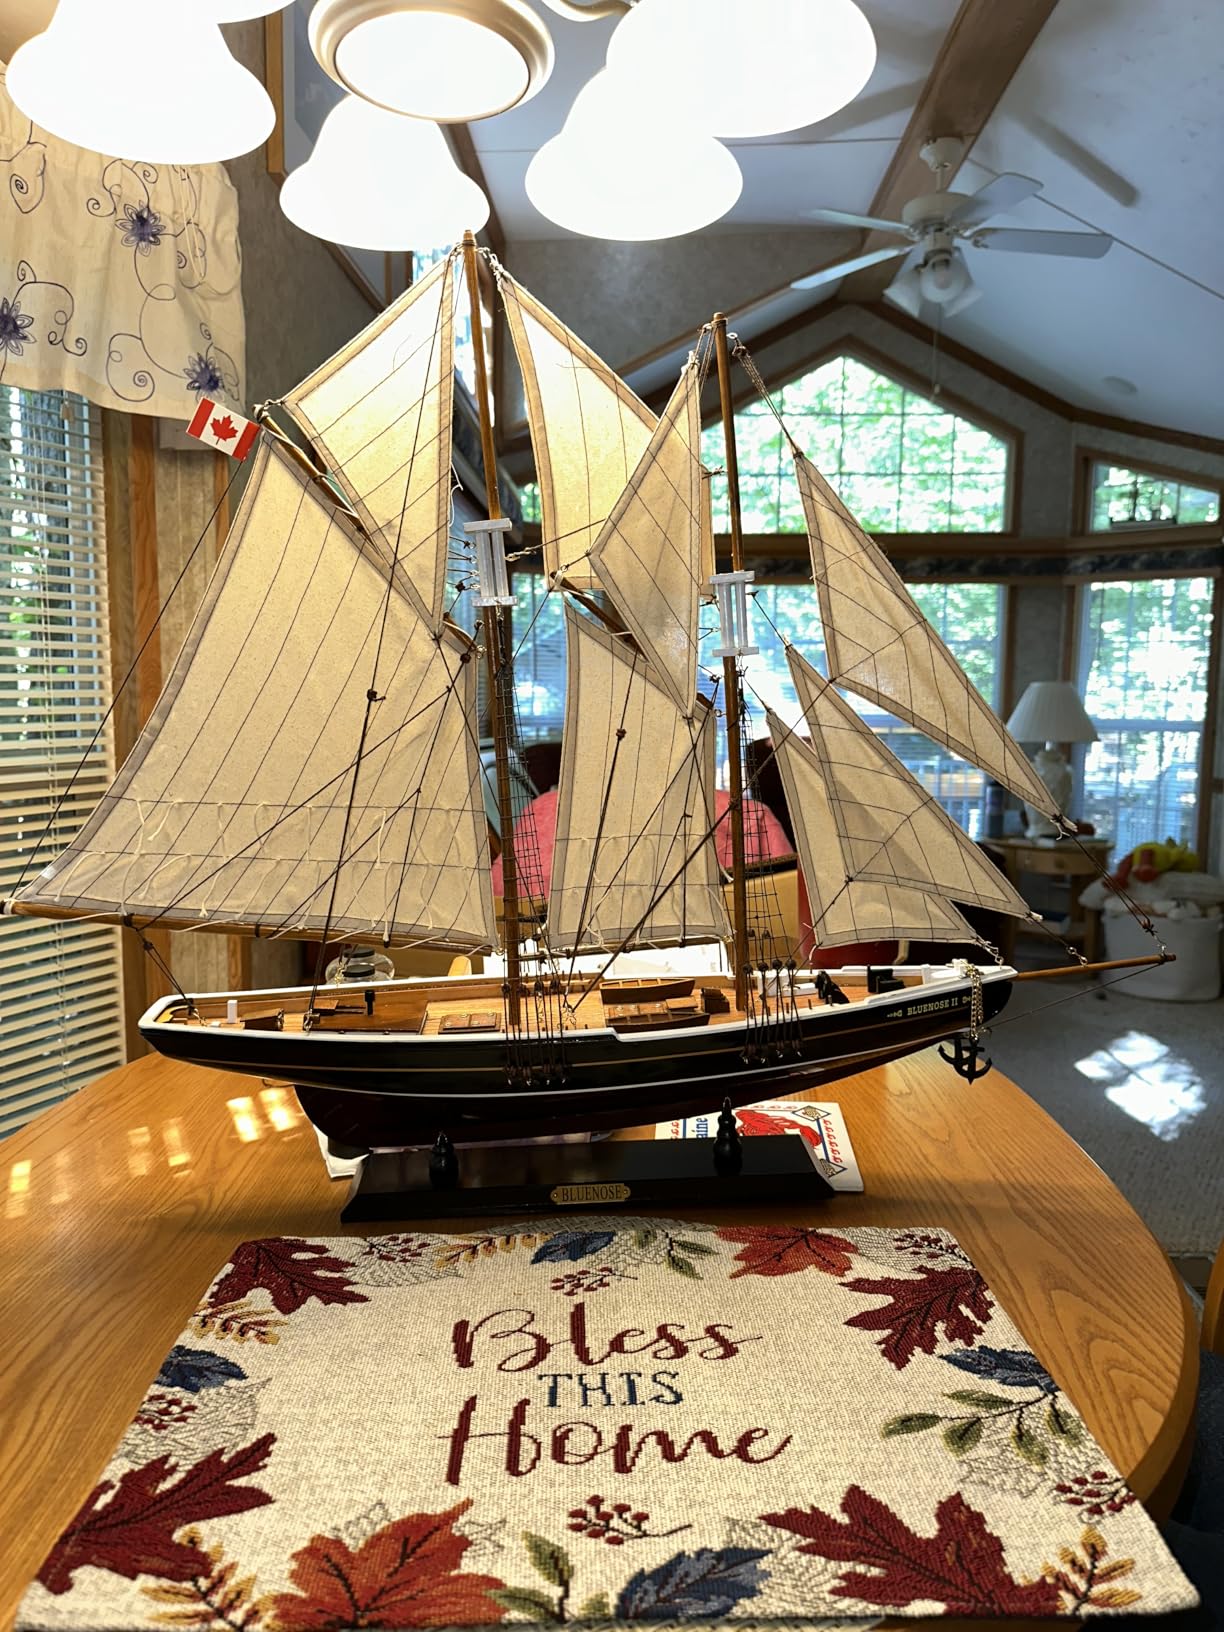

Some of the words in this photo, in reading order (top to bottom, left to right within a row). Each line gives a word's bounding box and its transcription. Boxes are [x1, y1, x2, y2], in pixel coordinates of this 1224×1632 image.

[907, 999, 950, 1016] BLUENOSE
[951, 997, 959, 1007] II
[691, 1117, 708, 1138] aine
[561, 1184, 622, 1202] BLUENOSE
[451, 1300, 763, 1372] Bless
[538, 1371, 684, 1408] THIS
[437, 1394, 793, 1486] Home
